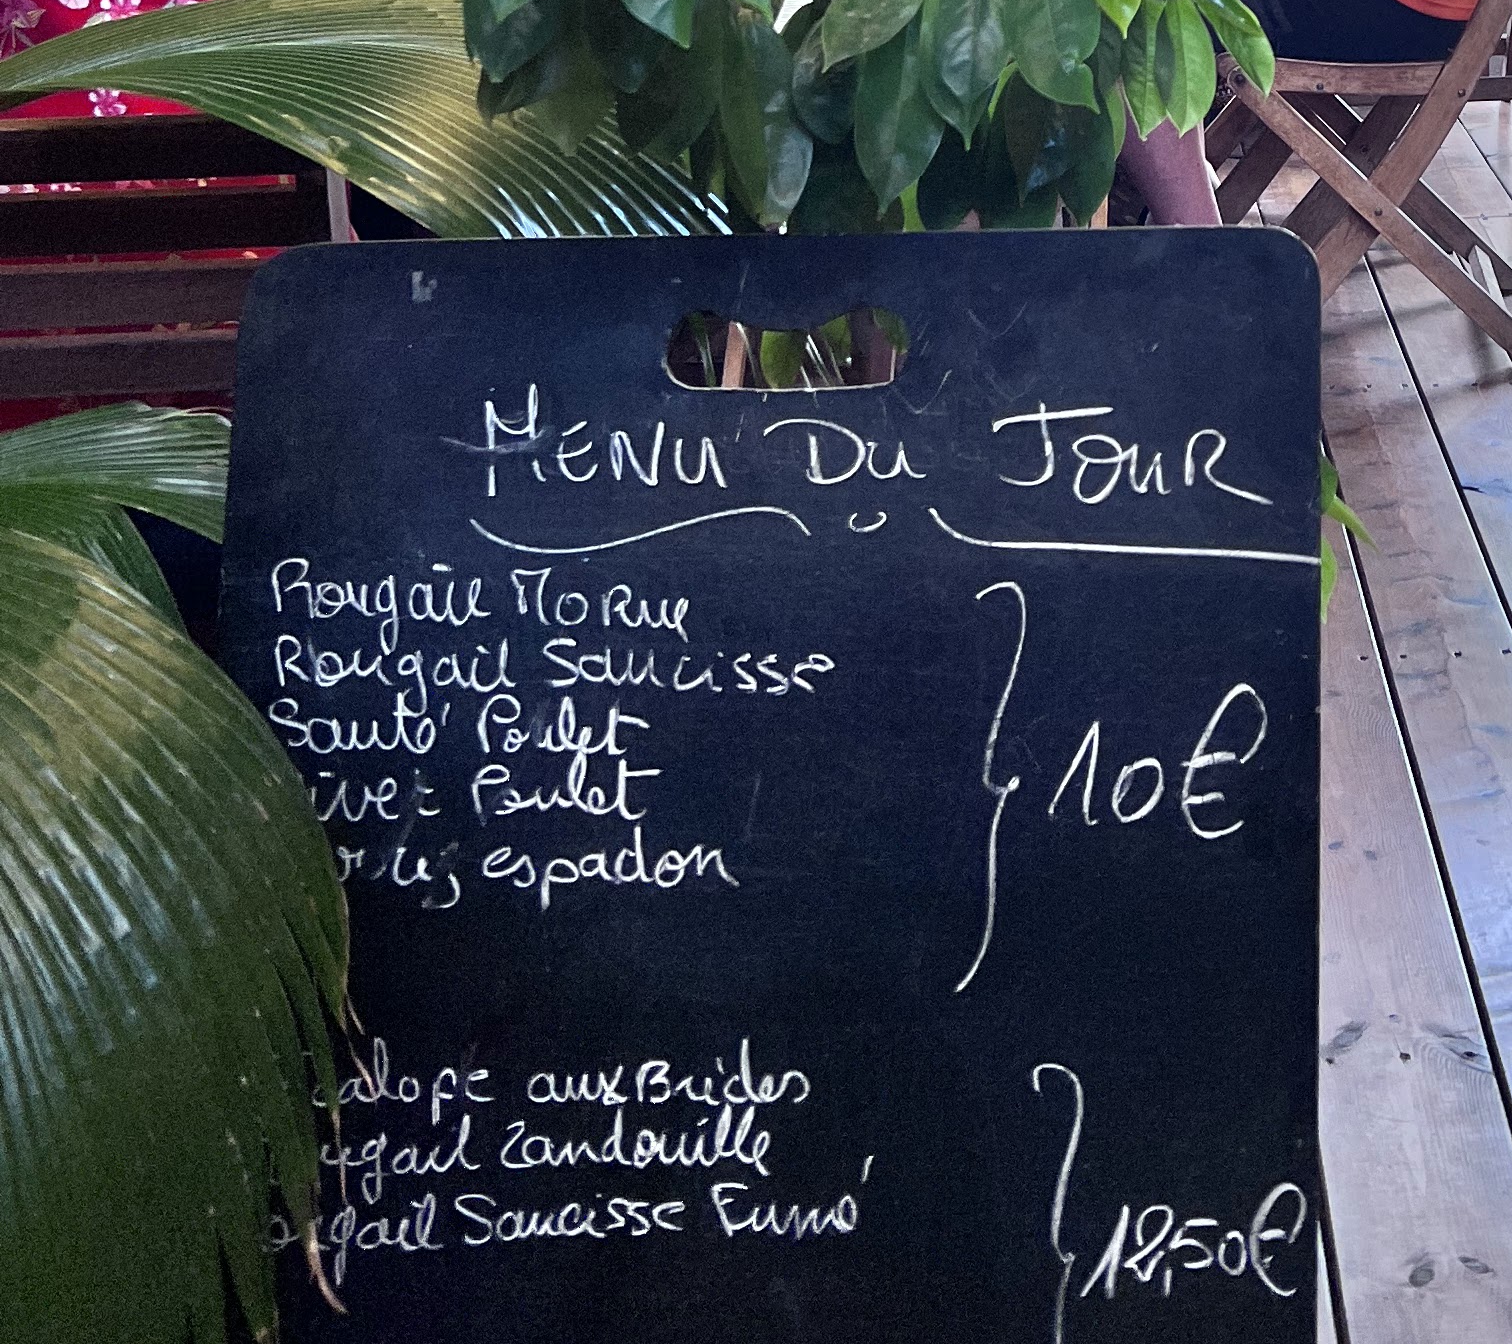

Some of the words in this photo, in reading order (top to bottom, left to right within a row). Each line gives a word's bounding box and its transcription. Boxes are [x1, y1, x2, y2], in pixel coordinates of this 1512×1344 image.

[274, 635, 516, 709] Rougail
[541, 637, 836, 696] Saucisse
[481, 826, 740, 912] espadon
[319, 1114, 482, 1205] ugail
[262, 1192, 445, 1287] ogail
[454, 1193, 686, 1246] Saucisse
